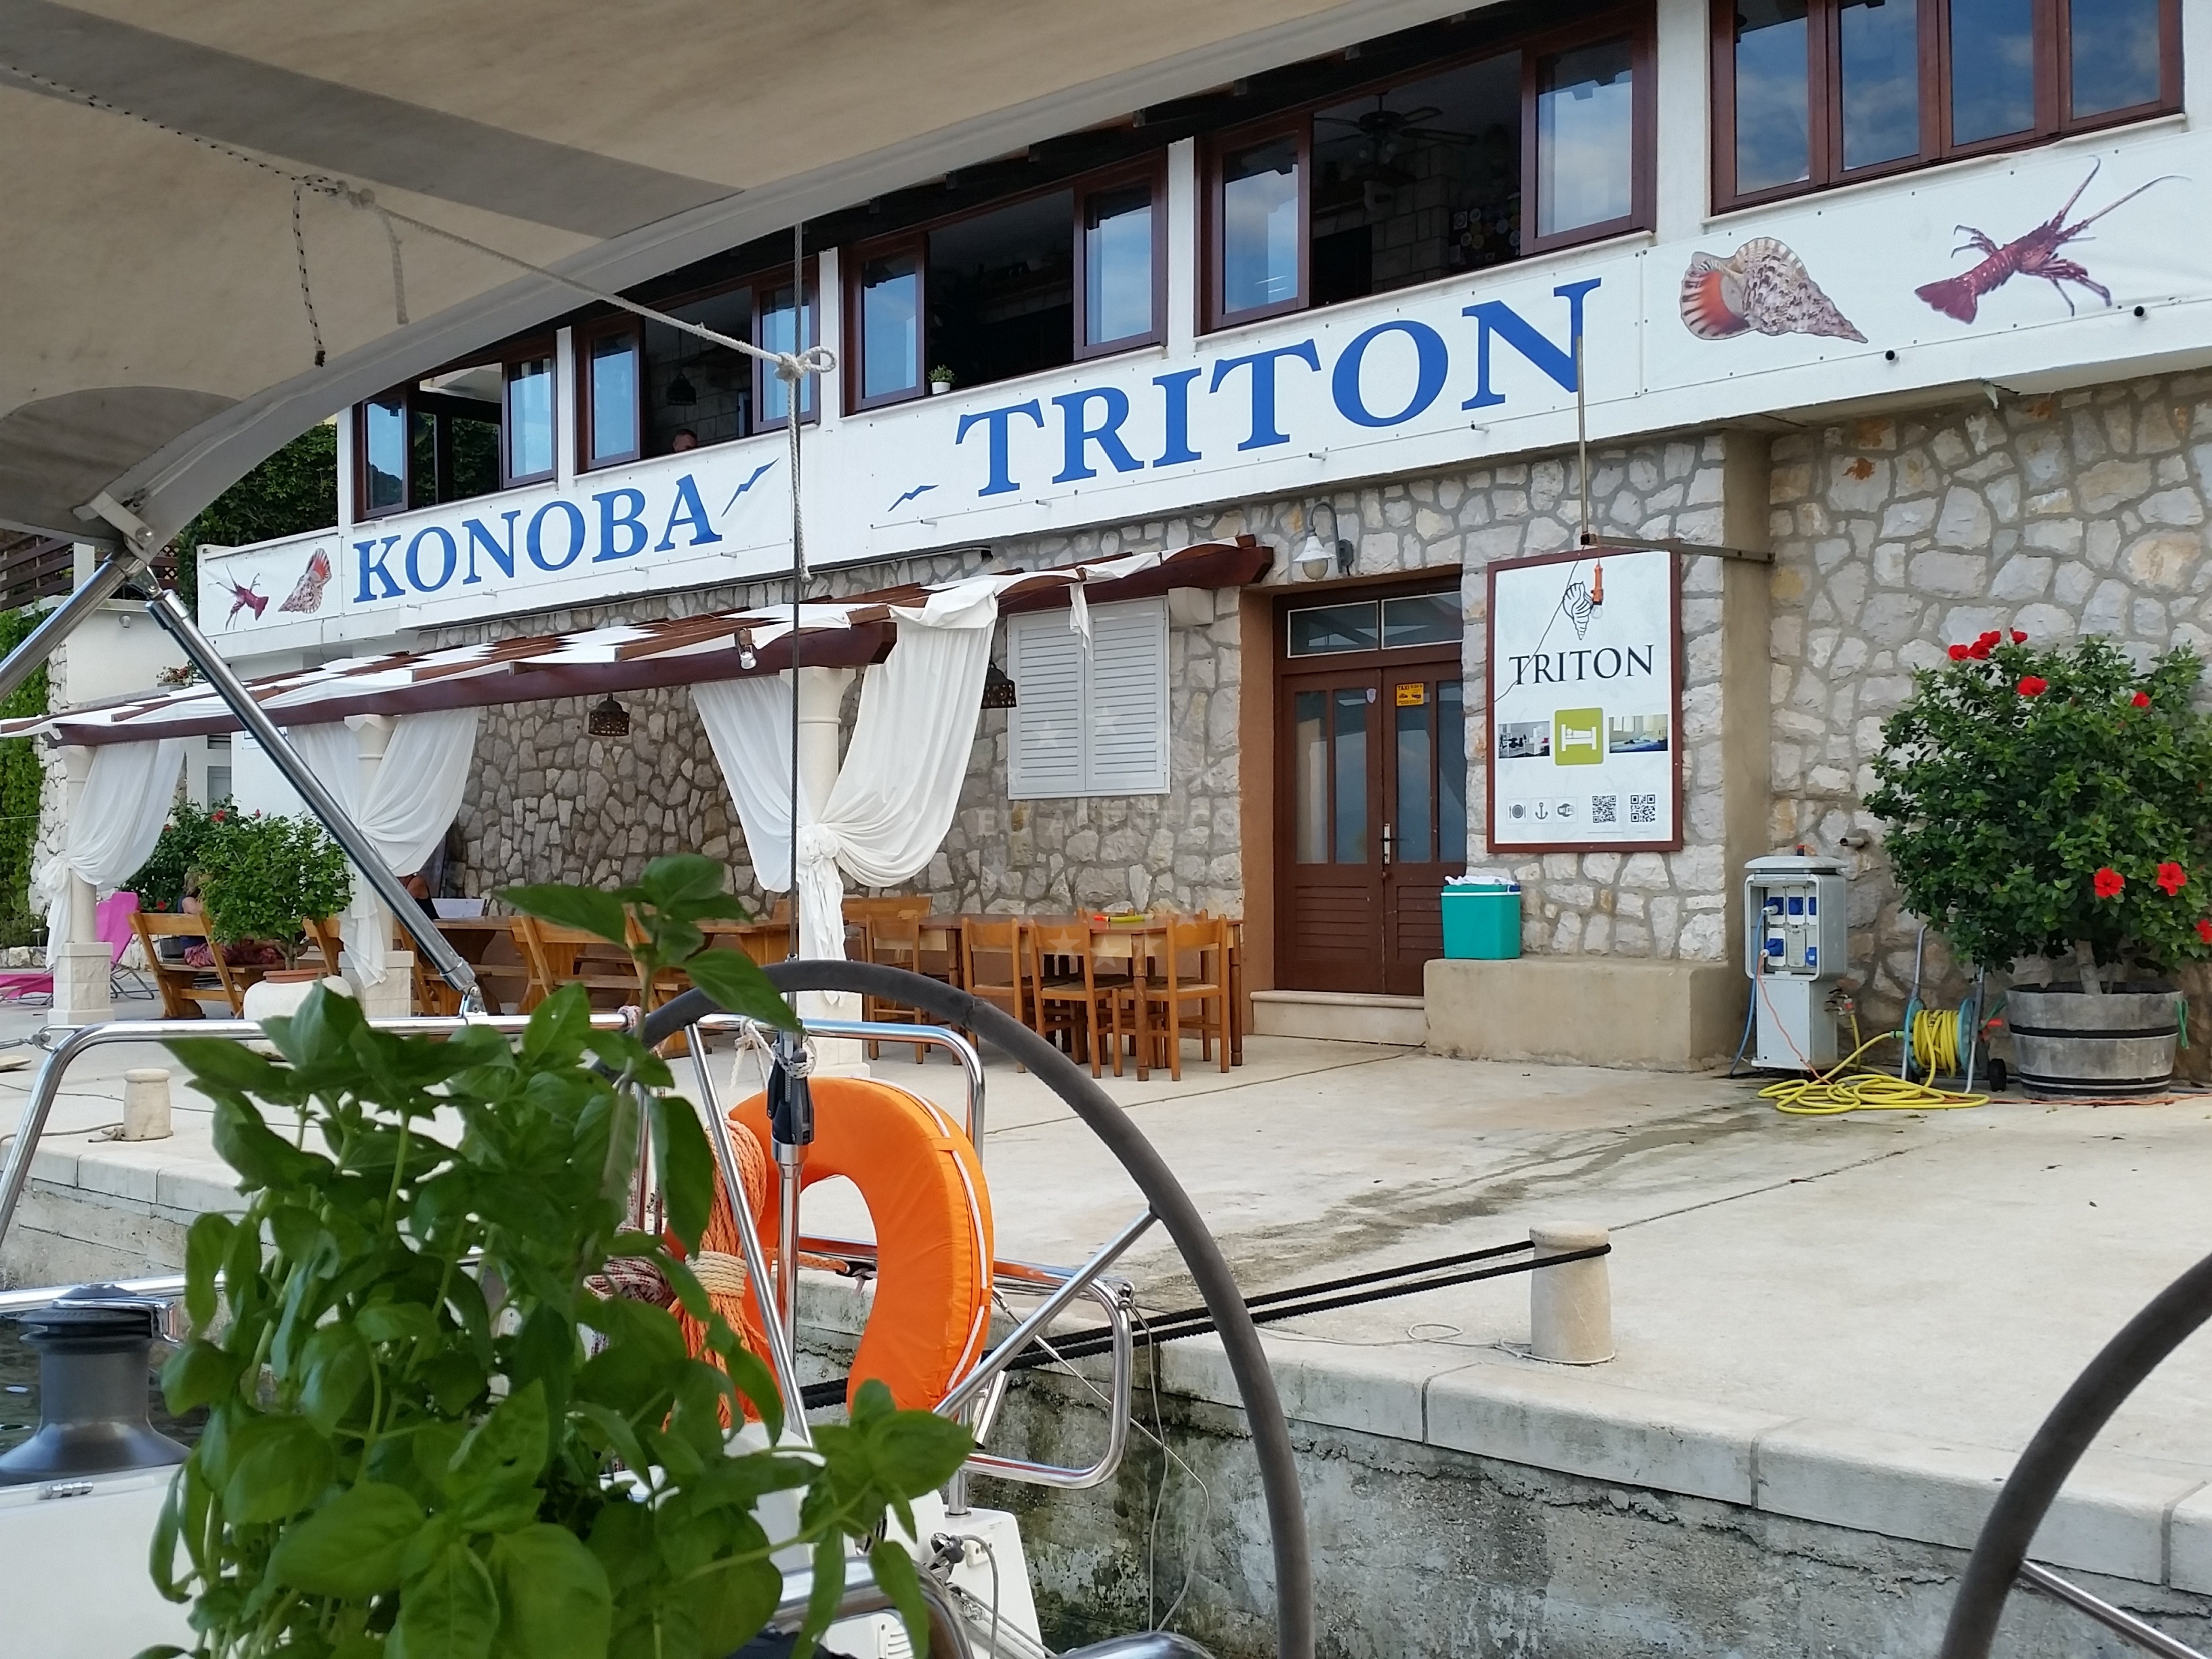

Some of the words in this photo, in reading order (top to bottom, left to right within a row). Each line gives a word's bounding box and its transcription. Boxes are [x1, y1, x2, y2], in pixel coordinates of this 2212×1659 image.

[352, 473, 722, 603] KONOBA
[955, 277, 1602, 497] TRITON
[1508, 644, 1654, 686] TRITON
